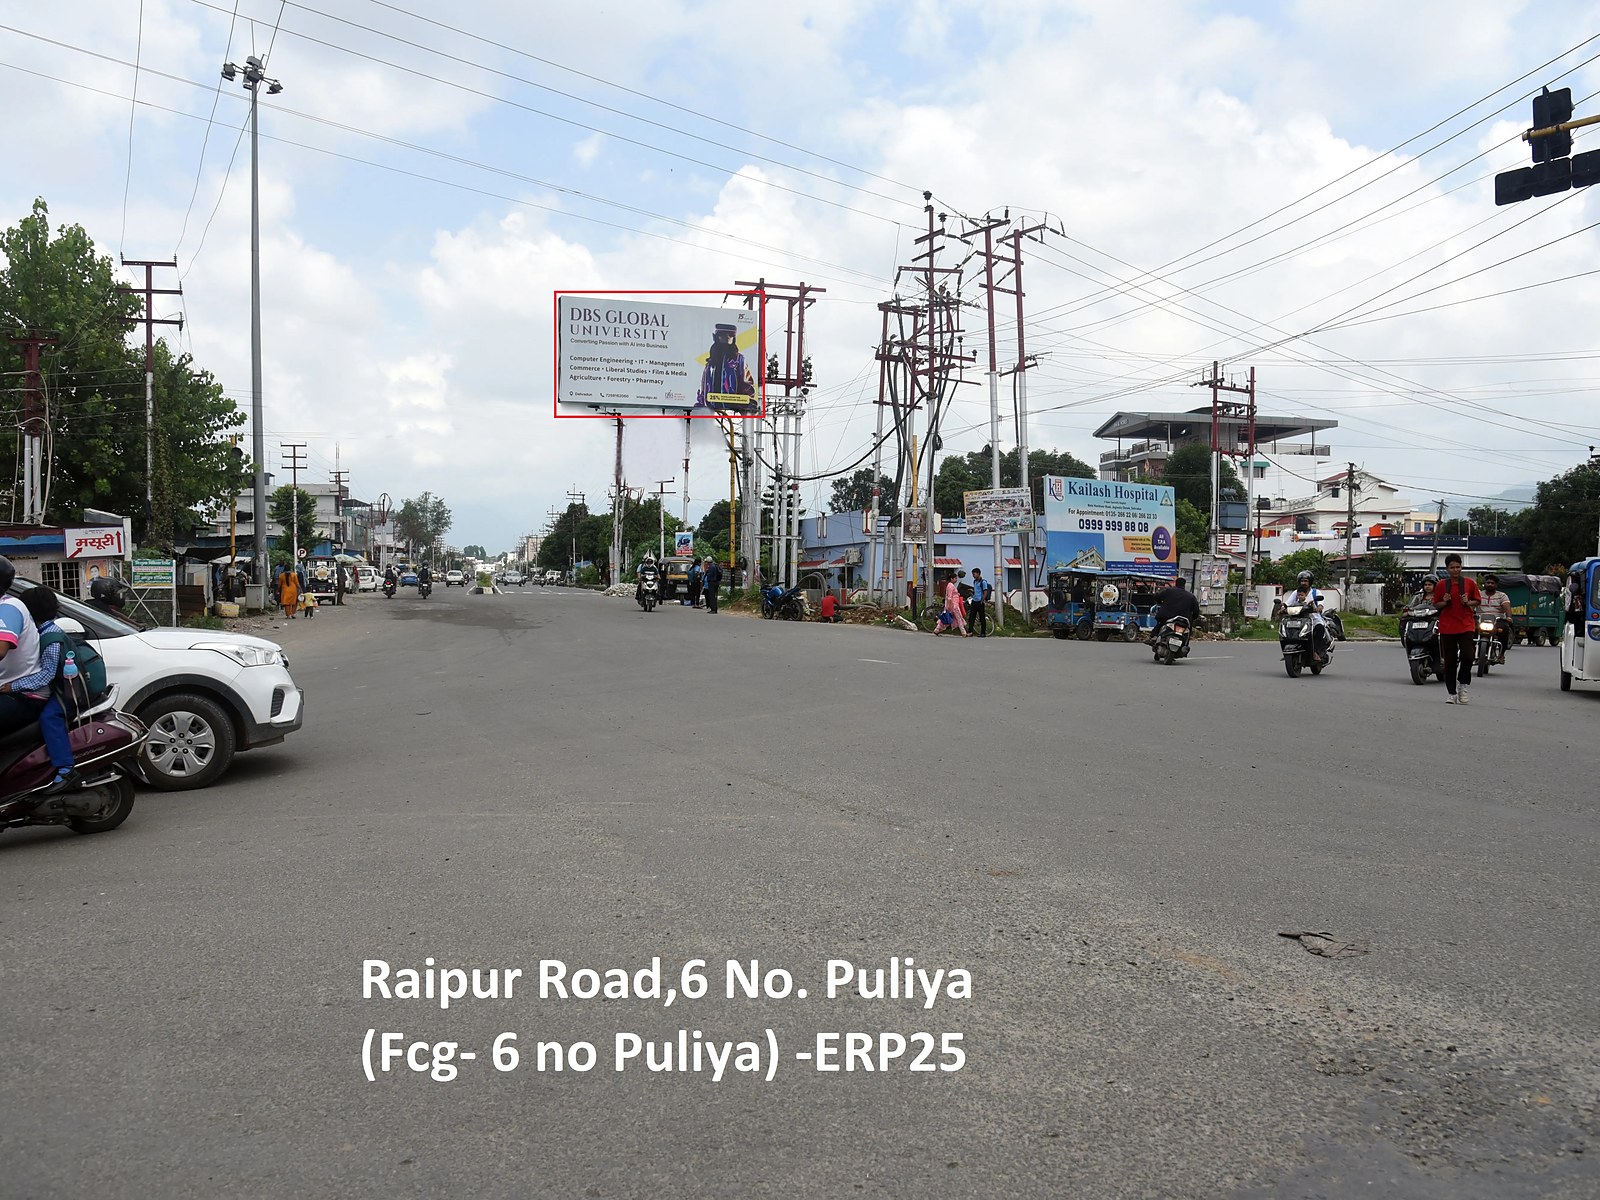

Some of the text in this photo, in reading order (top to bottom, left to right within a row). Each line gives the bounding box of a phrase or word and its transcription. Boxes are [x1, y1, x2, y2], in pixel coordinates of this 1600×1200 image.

[570, 307, 669, 328] DBS GLOBAL
[570, 324, 668, 341] UNIVERSITY
[569, 355, 598, 363] Computer
[599, 357, 633, 365] Engineering
[607, 376, 631, 384] Forestry
[1068, 481, 1158, 503] Kailash Hospital
[1076, 509, 1104, 517] Appointment:
[1079, 518, 1149, 533] 0999 999 88 08
[75, 533, 115, 550] मसूरी
